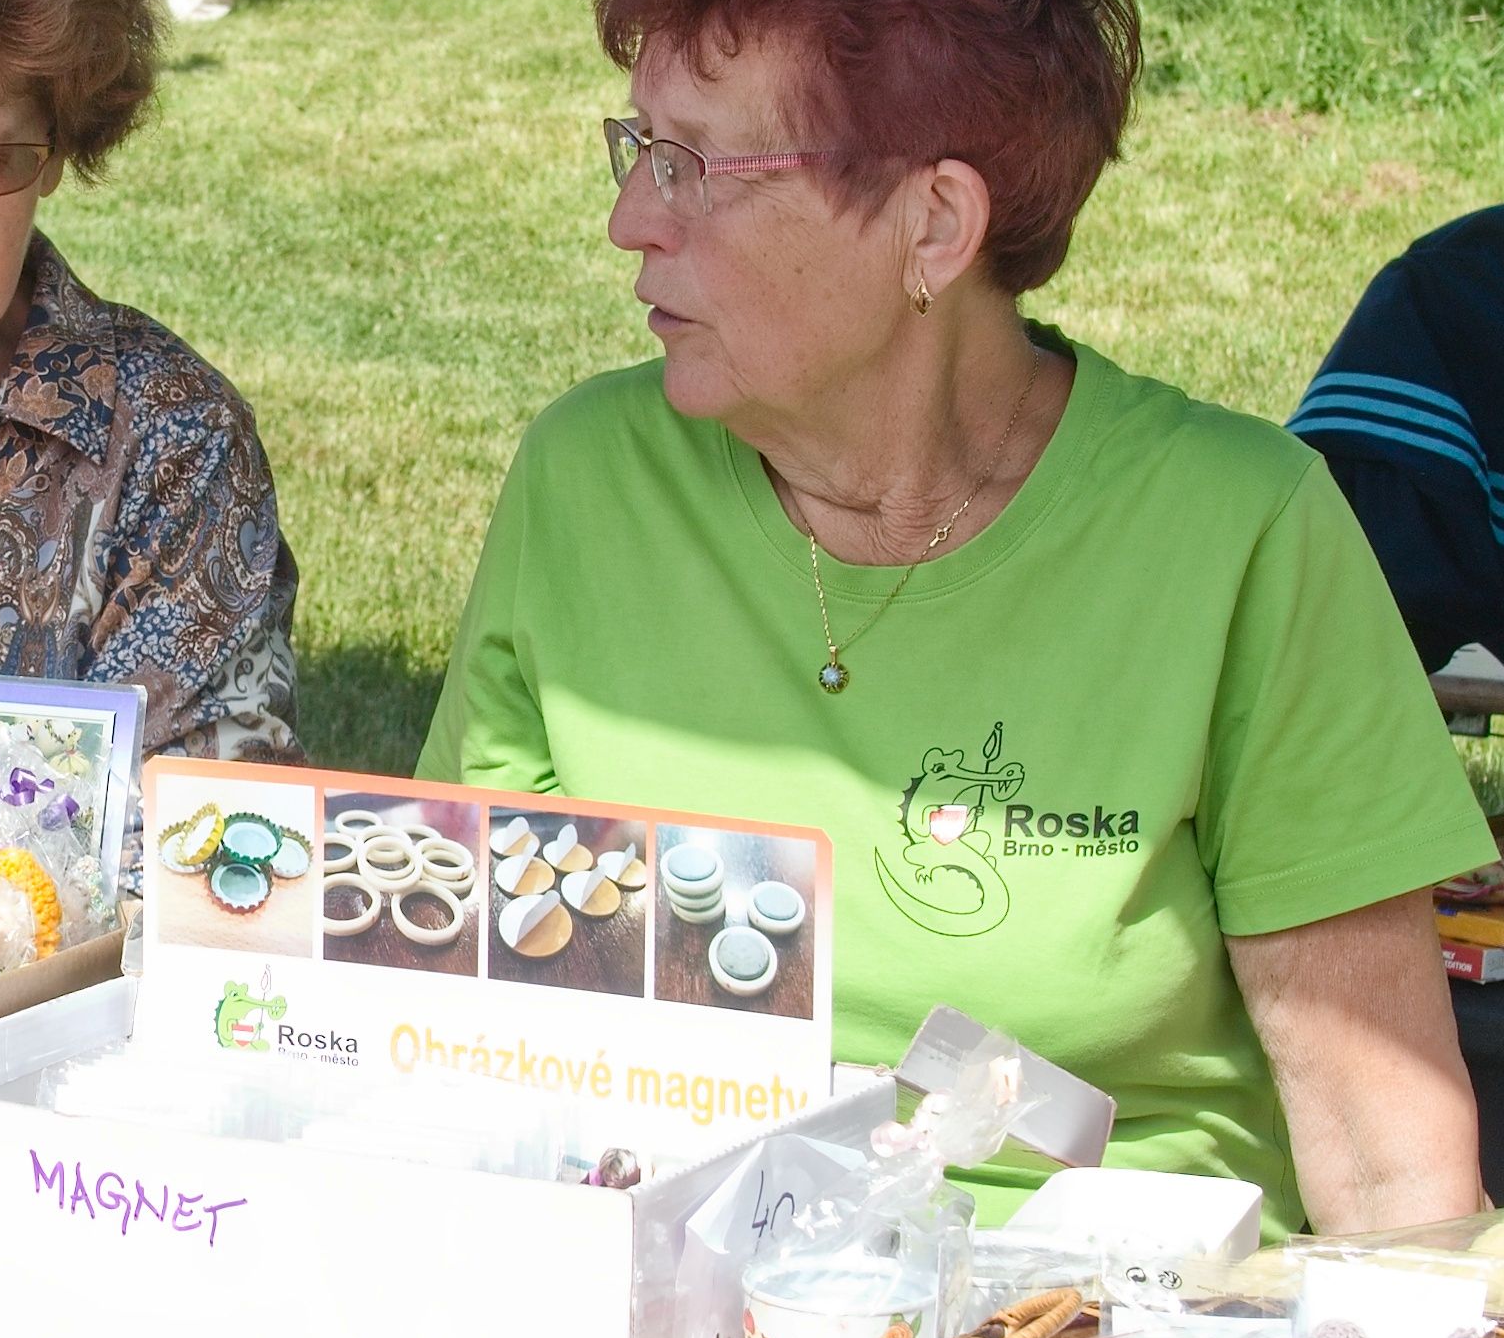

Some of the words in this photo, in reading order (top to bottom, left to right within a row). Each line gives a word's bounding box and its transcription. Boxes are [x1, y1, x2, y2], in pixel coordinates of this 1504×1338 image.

[1004, 804, 1139, 838] Roska
[1003, 839, 1054, 858] Brno
[1076, 837, 1139, 858] město
[277, 1023, 359, 1055] Roska
[320, 1050, 359, 1068] město
[30, 1149, 247, 1247] MAGNET
